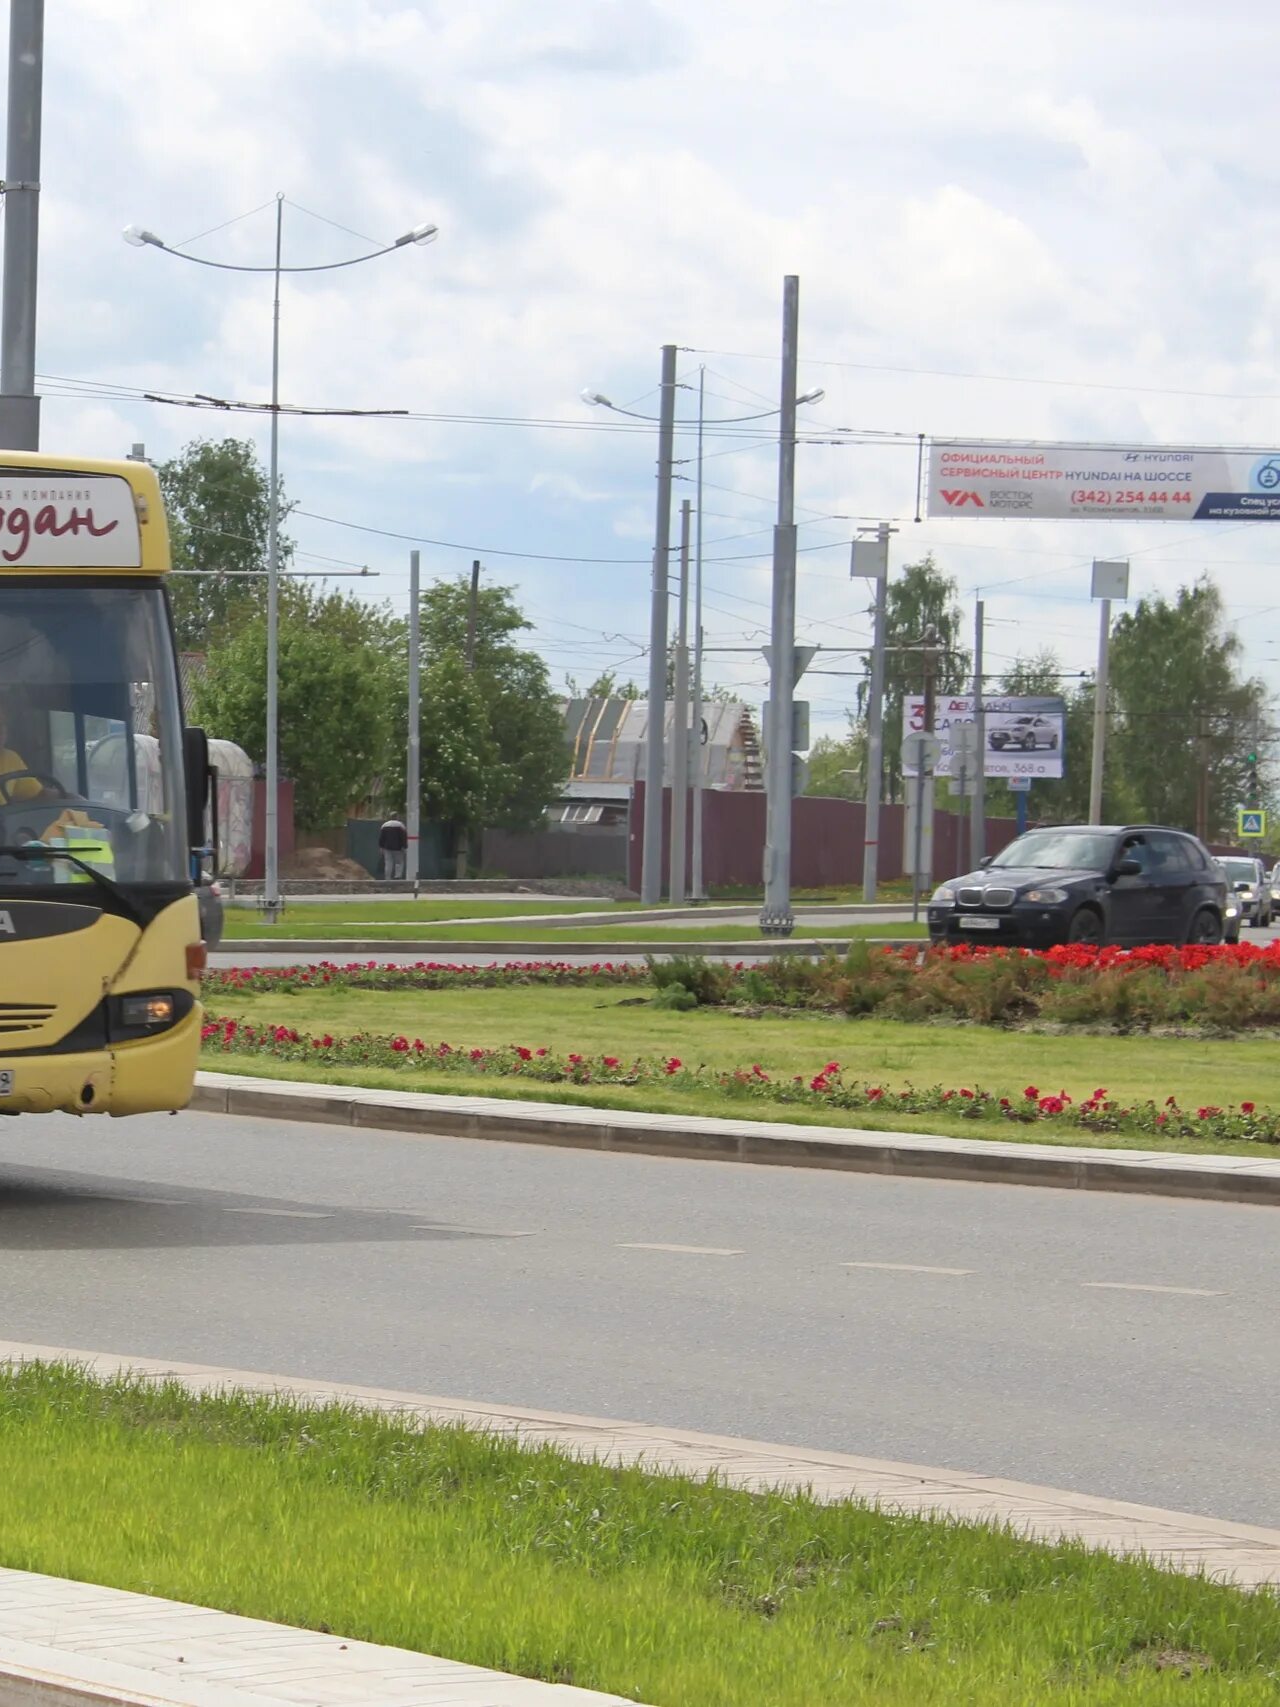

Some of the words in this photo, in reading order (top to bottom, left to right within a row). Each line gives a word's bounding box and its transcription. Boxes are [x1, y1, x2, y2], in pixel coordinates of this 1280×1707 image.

[941, 452, 1045, 465] ОФИЦИАЛЬНЫЙ
[940, 467, 1020, 478] СЕРВИСНЫЙ
[1022, 470, 1063, 480] ЦЕНТР
[1065, 471, 1121, 481] HYUNDAI
[1125, 472, 1142, 481] НА
[1144, 472, 1193, 481] ШОССЕ
[23, 490, 91, 501] КОМПАНИЯ
[990, 490, 1033, 499] ВОСТОК
[1071, 490, 1111, 505] (342)
[1115, 491, 1144, 503] 254
[1148, 492, 1168, 503] 44
[1172, 492, 1191, 503] 44
[990, 500, 1033, 510] МОТОРС
